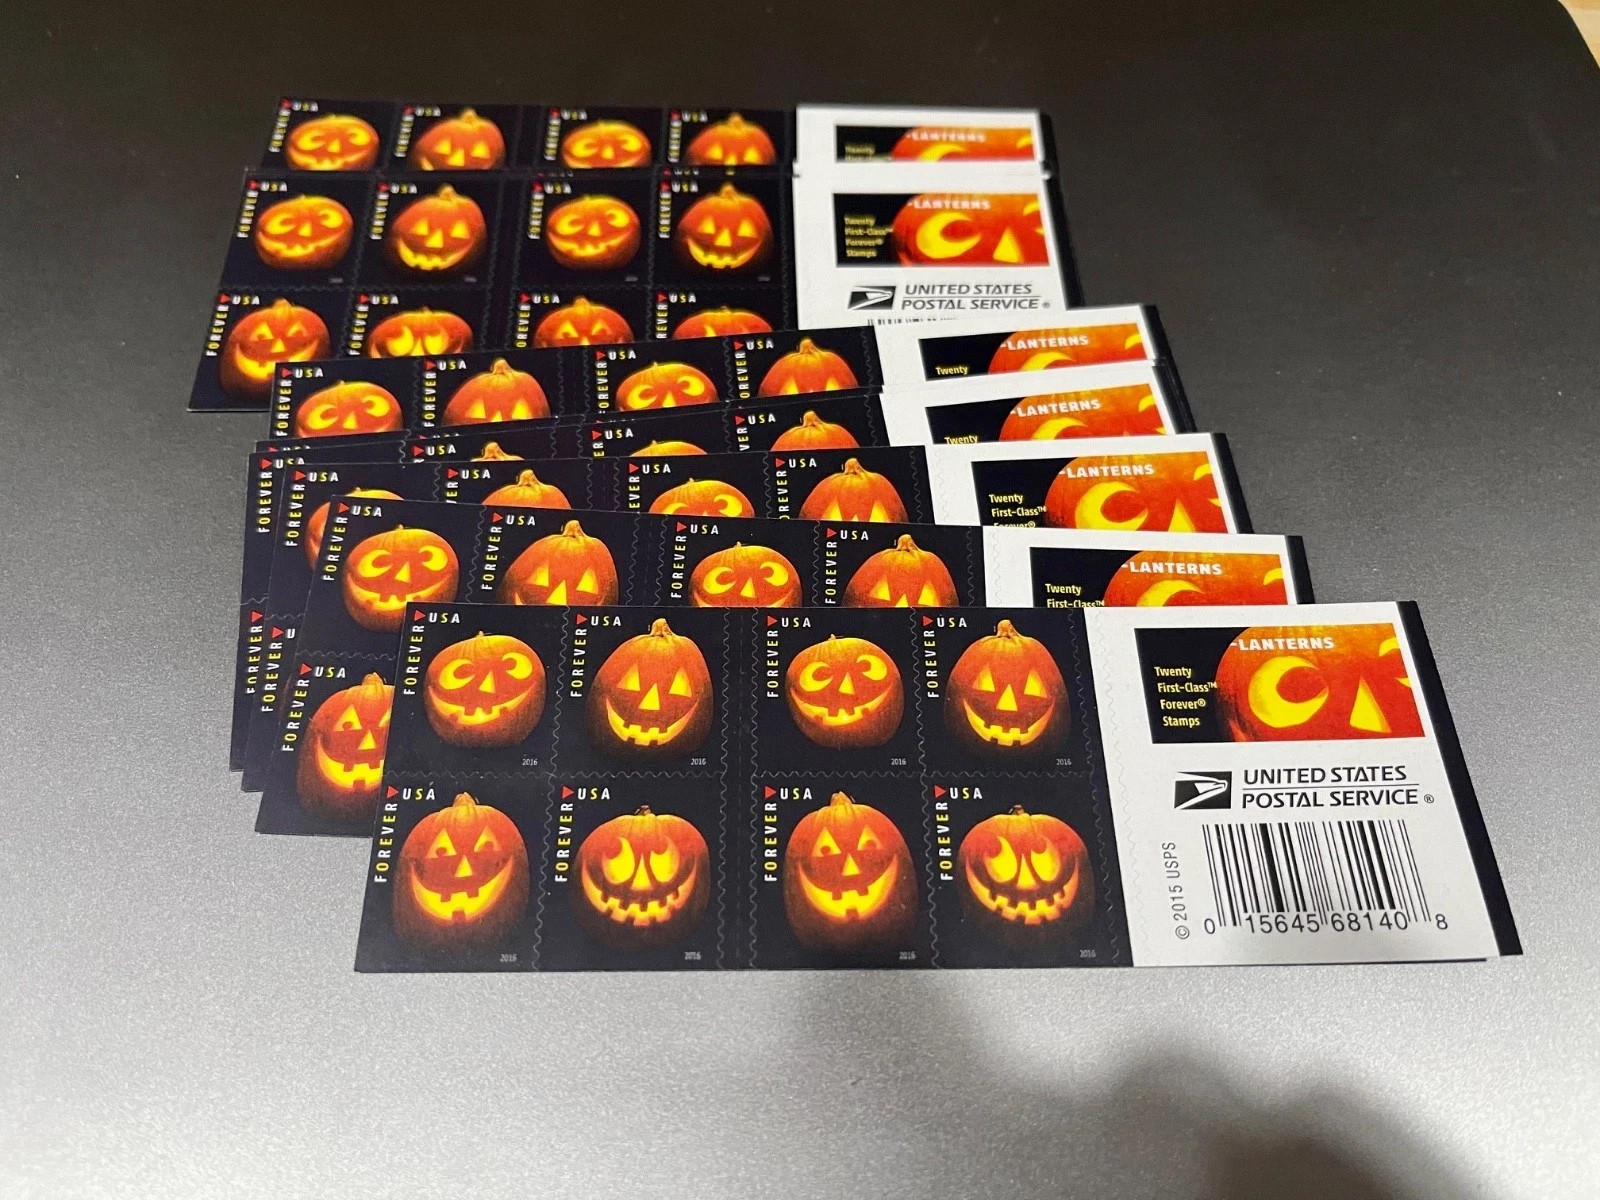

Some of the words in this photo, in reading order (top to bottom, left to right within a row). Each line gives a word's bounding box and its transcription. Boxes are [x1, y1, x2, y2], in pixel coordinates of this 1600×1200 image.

[905, 284, 972, 295] UNITED
[973, 284, 1033, 295] STATES
[232, 294, 261, 306] USA
[370, 294, 399, 306] USA
[532, 293, 560, 304] USA
[669, 292, 697, 303] USA
[901, 299, 965, 310] POSTAL
[970, 299, 1039, 310] SERVICE
[516, 303, 532, 348] OREVER
[655, 302, 669, 339] REVER
[206, 305, 230, 357] FOREVER
[348, 305, 370, 356] FOREVER
[746, 339, 774, 350] USA
[608, 350, 637, 361] USA
[439, 359, 467, 371] USA
[935, 364, 969, 377] Twenty
[294, 366, 325, 378] USA
[735, 351, 751, 400] OREVER
[596, 361, 609, 414] OREVER
[424, 371, 437, 429] FOREVER
[275, 379, 293, 437] FOREVER
[748, 413, 776, 425] USA
[604, 428, 634, 440] USA
[427, 444, 457, 456] USA
[642, 463, 672, 474] USA
[788, 457, 818, 468] USA
[309, 471, 340, 482] USA
[461, 468, 491, 479] USA
[628, 476, 641, 513] EVER
[776, 470, 791, 520] OREVER
[988, 493, 1024, 505] Twenty
[258, 472, 274, 534] FOREVER
[285, 483, 306, 547] FOREVER
[352, 505, 383, 517] USA
[991, 505, 1048, 518] First-Class™
[505, 514, 536, 526] USA
[689, 523, 719, 535] USA
[839, 529, 869, 541] USA
[323, 516, 349, 582] FOREVER
[481, 525, 503, 591] FOREVER
[670, 535, 688, 599] FOREVER
[825, 541, 838, 605] FOREVER
[1045, 583, 1082, 596] Twenty
[428, 611, 461, 624] USA
[590, 614, 622, 627] USA
[780, 615, 812, 628] USA
[936, 615, 968, 628] USA
[246, 625, 264, 695] FOREVER
[403, 624, 426, 696] FOREVER
[570, 628, 588, 698] FOREVER
[766, 629, 780, 699] FOREVER
[924, 629, 940, 699] FOREVER
[261, 642, 283, 713] FOREVER
[314, 666, 348, 679] USA
[1154, 666, 1193, 679] Twenty
[1157, 681, 1219, 694] First-Class™
[1160, 698, 1207, 710] Forever®
[281, 679, 311, 752] FOREVER
[1162, 716, 1201, 728] Stamps
[522, 758, 538, 766] 2016
[690, 758, 707, 766] 2016
[891, 758, 907, 766] 2016
[1056, 758, 1072, 766] 2016
[1242, 767, 1326, 785] UNITED
[1330, 765, 1408, 783] STATES
[402, 787, 436, 800] USA
[577, 787, 611, 800] USA
[780, 787, 813, 800] USA
[949, 787, 983, 800] USA
[1241, 791, 1325, 809] POSTAL
[1329, 789, 1420, 807] SERVICE
[374, 802, 399, 883] FOREVER
[554, 802, 574, 883] FOREVER
[764, 802, 778, 882] FOREVER
[936, 801, 954, 881] FOREVER
[1161, 841, 1181, 880] USPS
[1167, 884, 1188, 922] 2015
[1203, 917, 1216, 935] 0
[1244, 912, 1321, 934] 15645
[1332, 911, 1409, 932] 68140
[1435, 912, 1449, 931] 8
